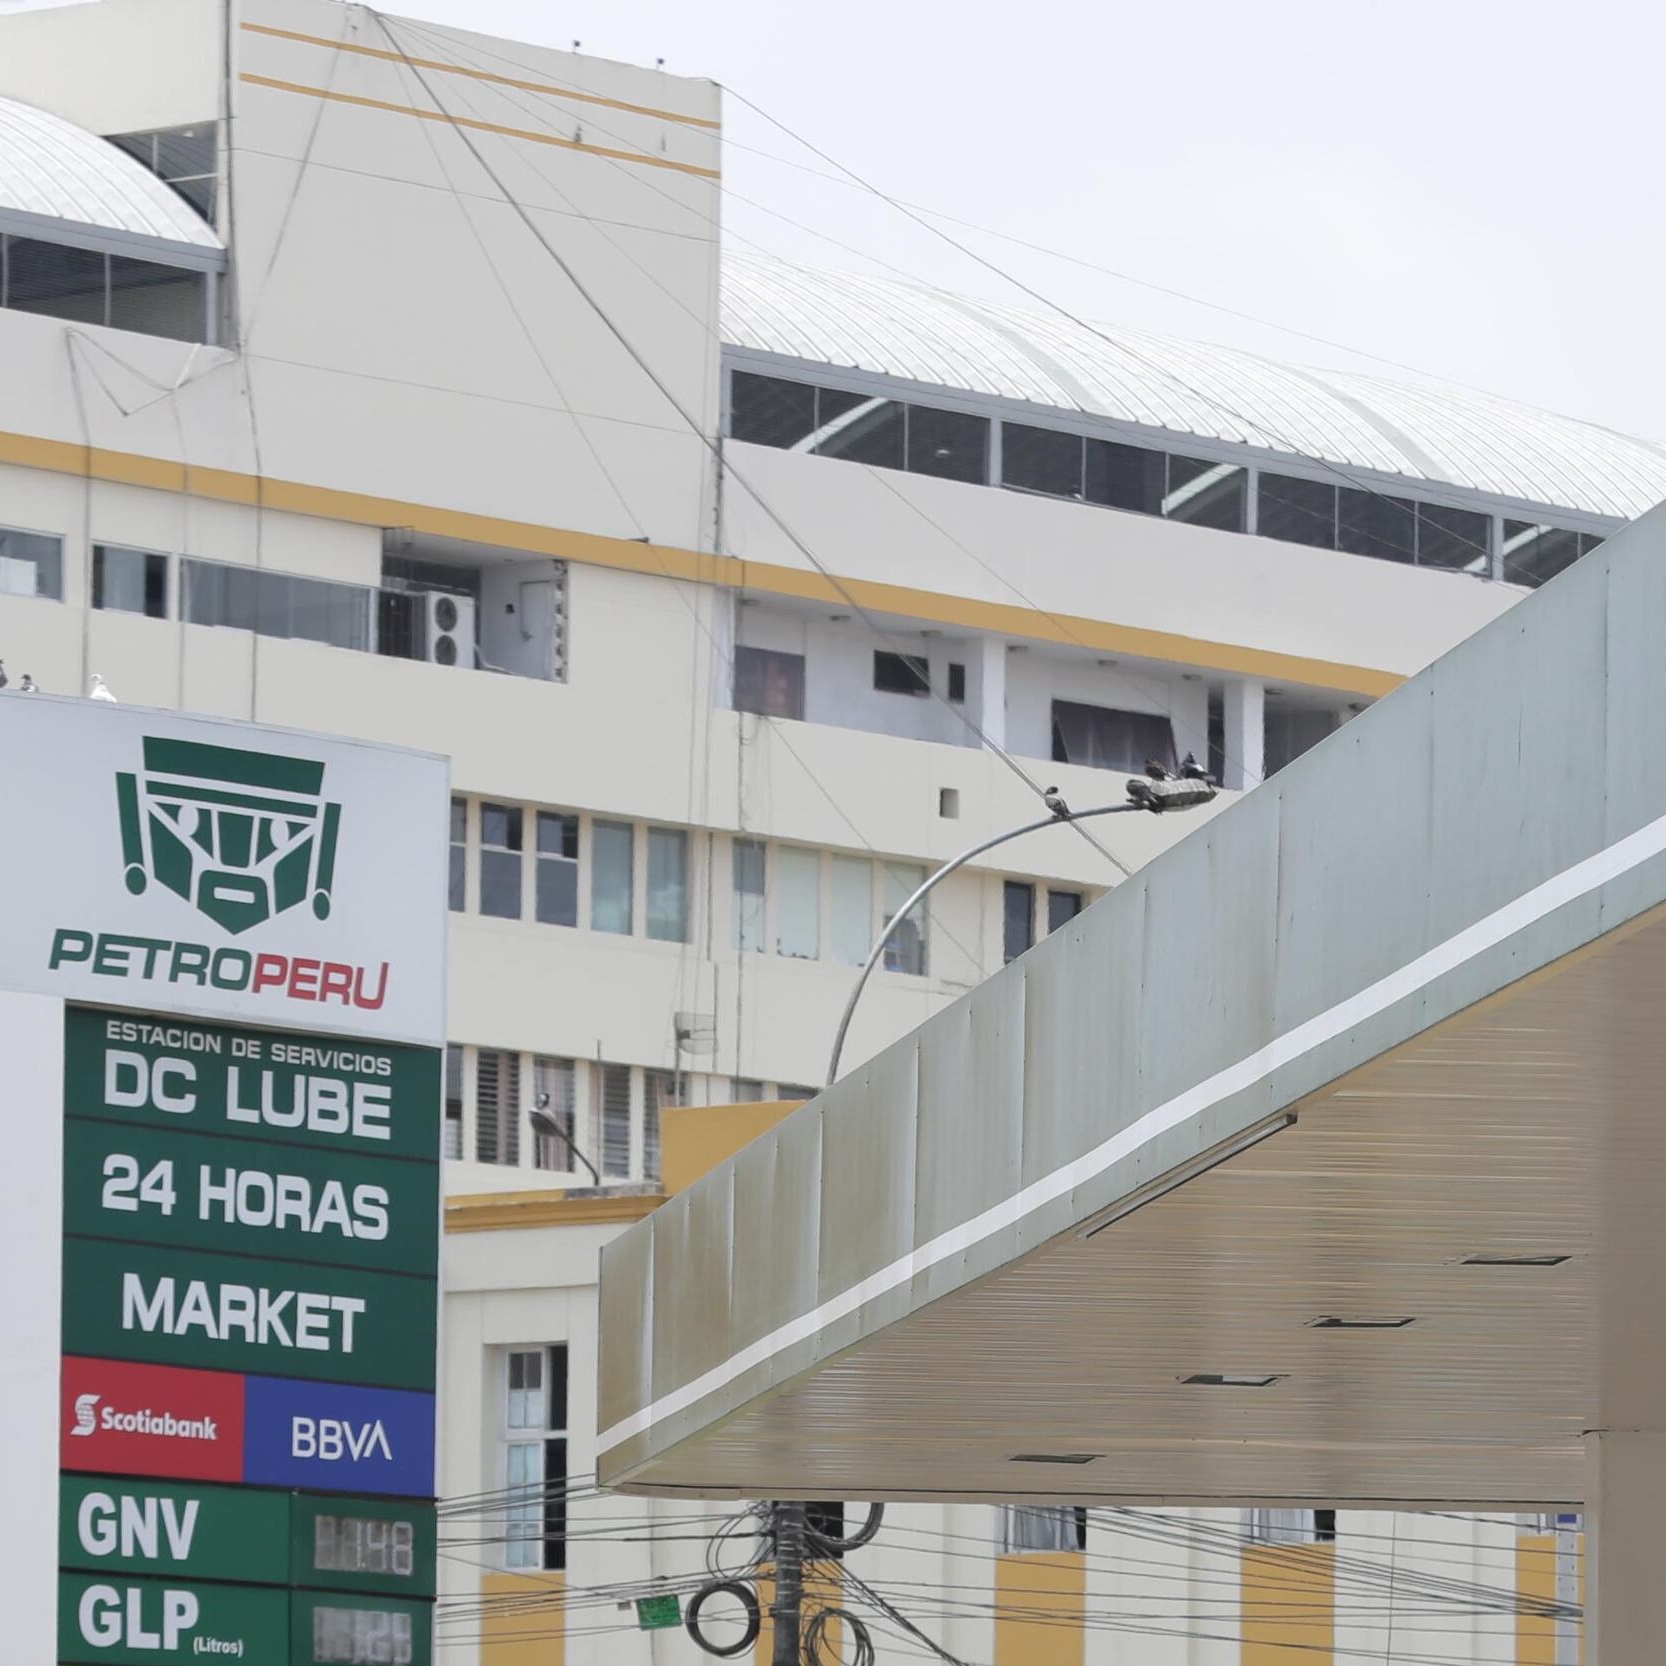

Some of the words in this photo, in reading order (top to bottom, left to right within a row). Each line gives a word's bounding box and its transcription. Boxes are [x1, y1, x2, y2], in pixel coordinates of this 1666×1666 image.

[106, 1020, 221, 1054] ESTACION
[231, 1037, 262, 1060] DE
[270, 1043, 392, 1076] SERVICIOS
[104, 1049, 197, 1114] DC
[226, 1066, 392, 1140] LUBE
[102, 1153, 177, 1216] 24
[199, 1164, 389, 1241] HORAS
[122, 1272, 366, 1353] MARKET
[100, 1405, 218, 1441] Scotiabank
[291, 1415, 393, 1462] BBVA
[77, 1491, 200, 1561] GNV
[77, 1584, 200, 1651] GLP
[192, 1635, 244, 1658] (Litros)
